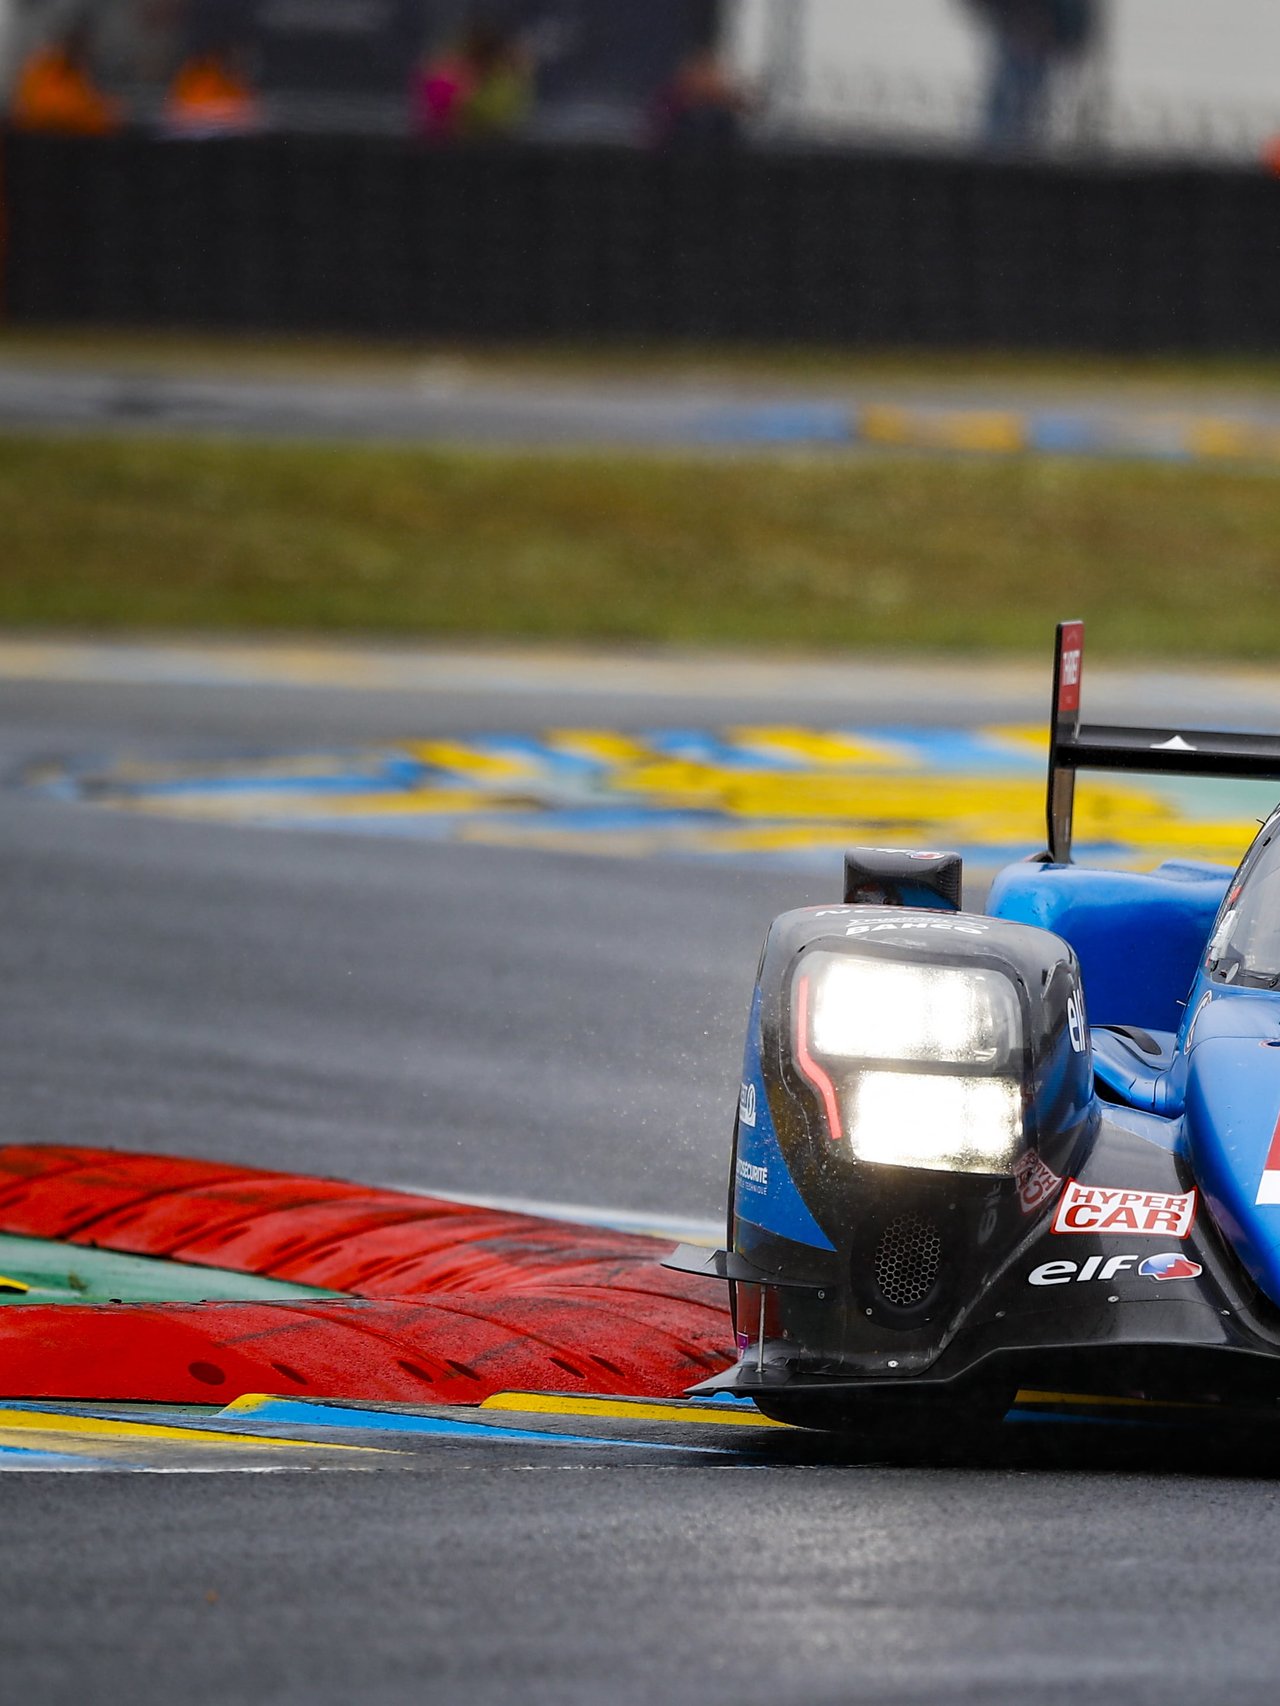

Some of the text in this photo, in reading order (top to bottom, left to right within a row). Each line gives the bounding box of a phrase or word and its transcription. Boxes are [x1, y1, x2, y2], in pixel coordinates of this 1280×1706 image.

[1070, 1188, 1188, 1212] HYPER
[1064, 1204, 1182, 1232] CAR
[1028, 1255, 1139, 1286] elf
